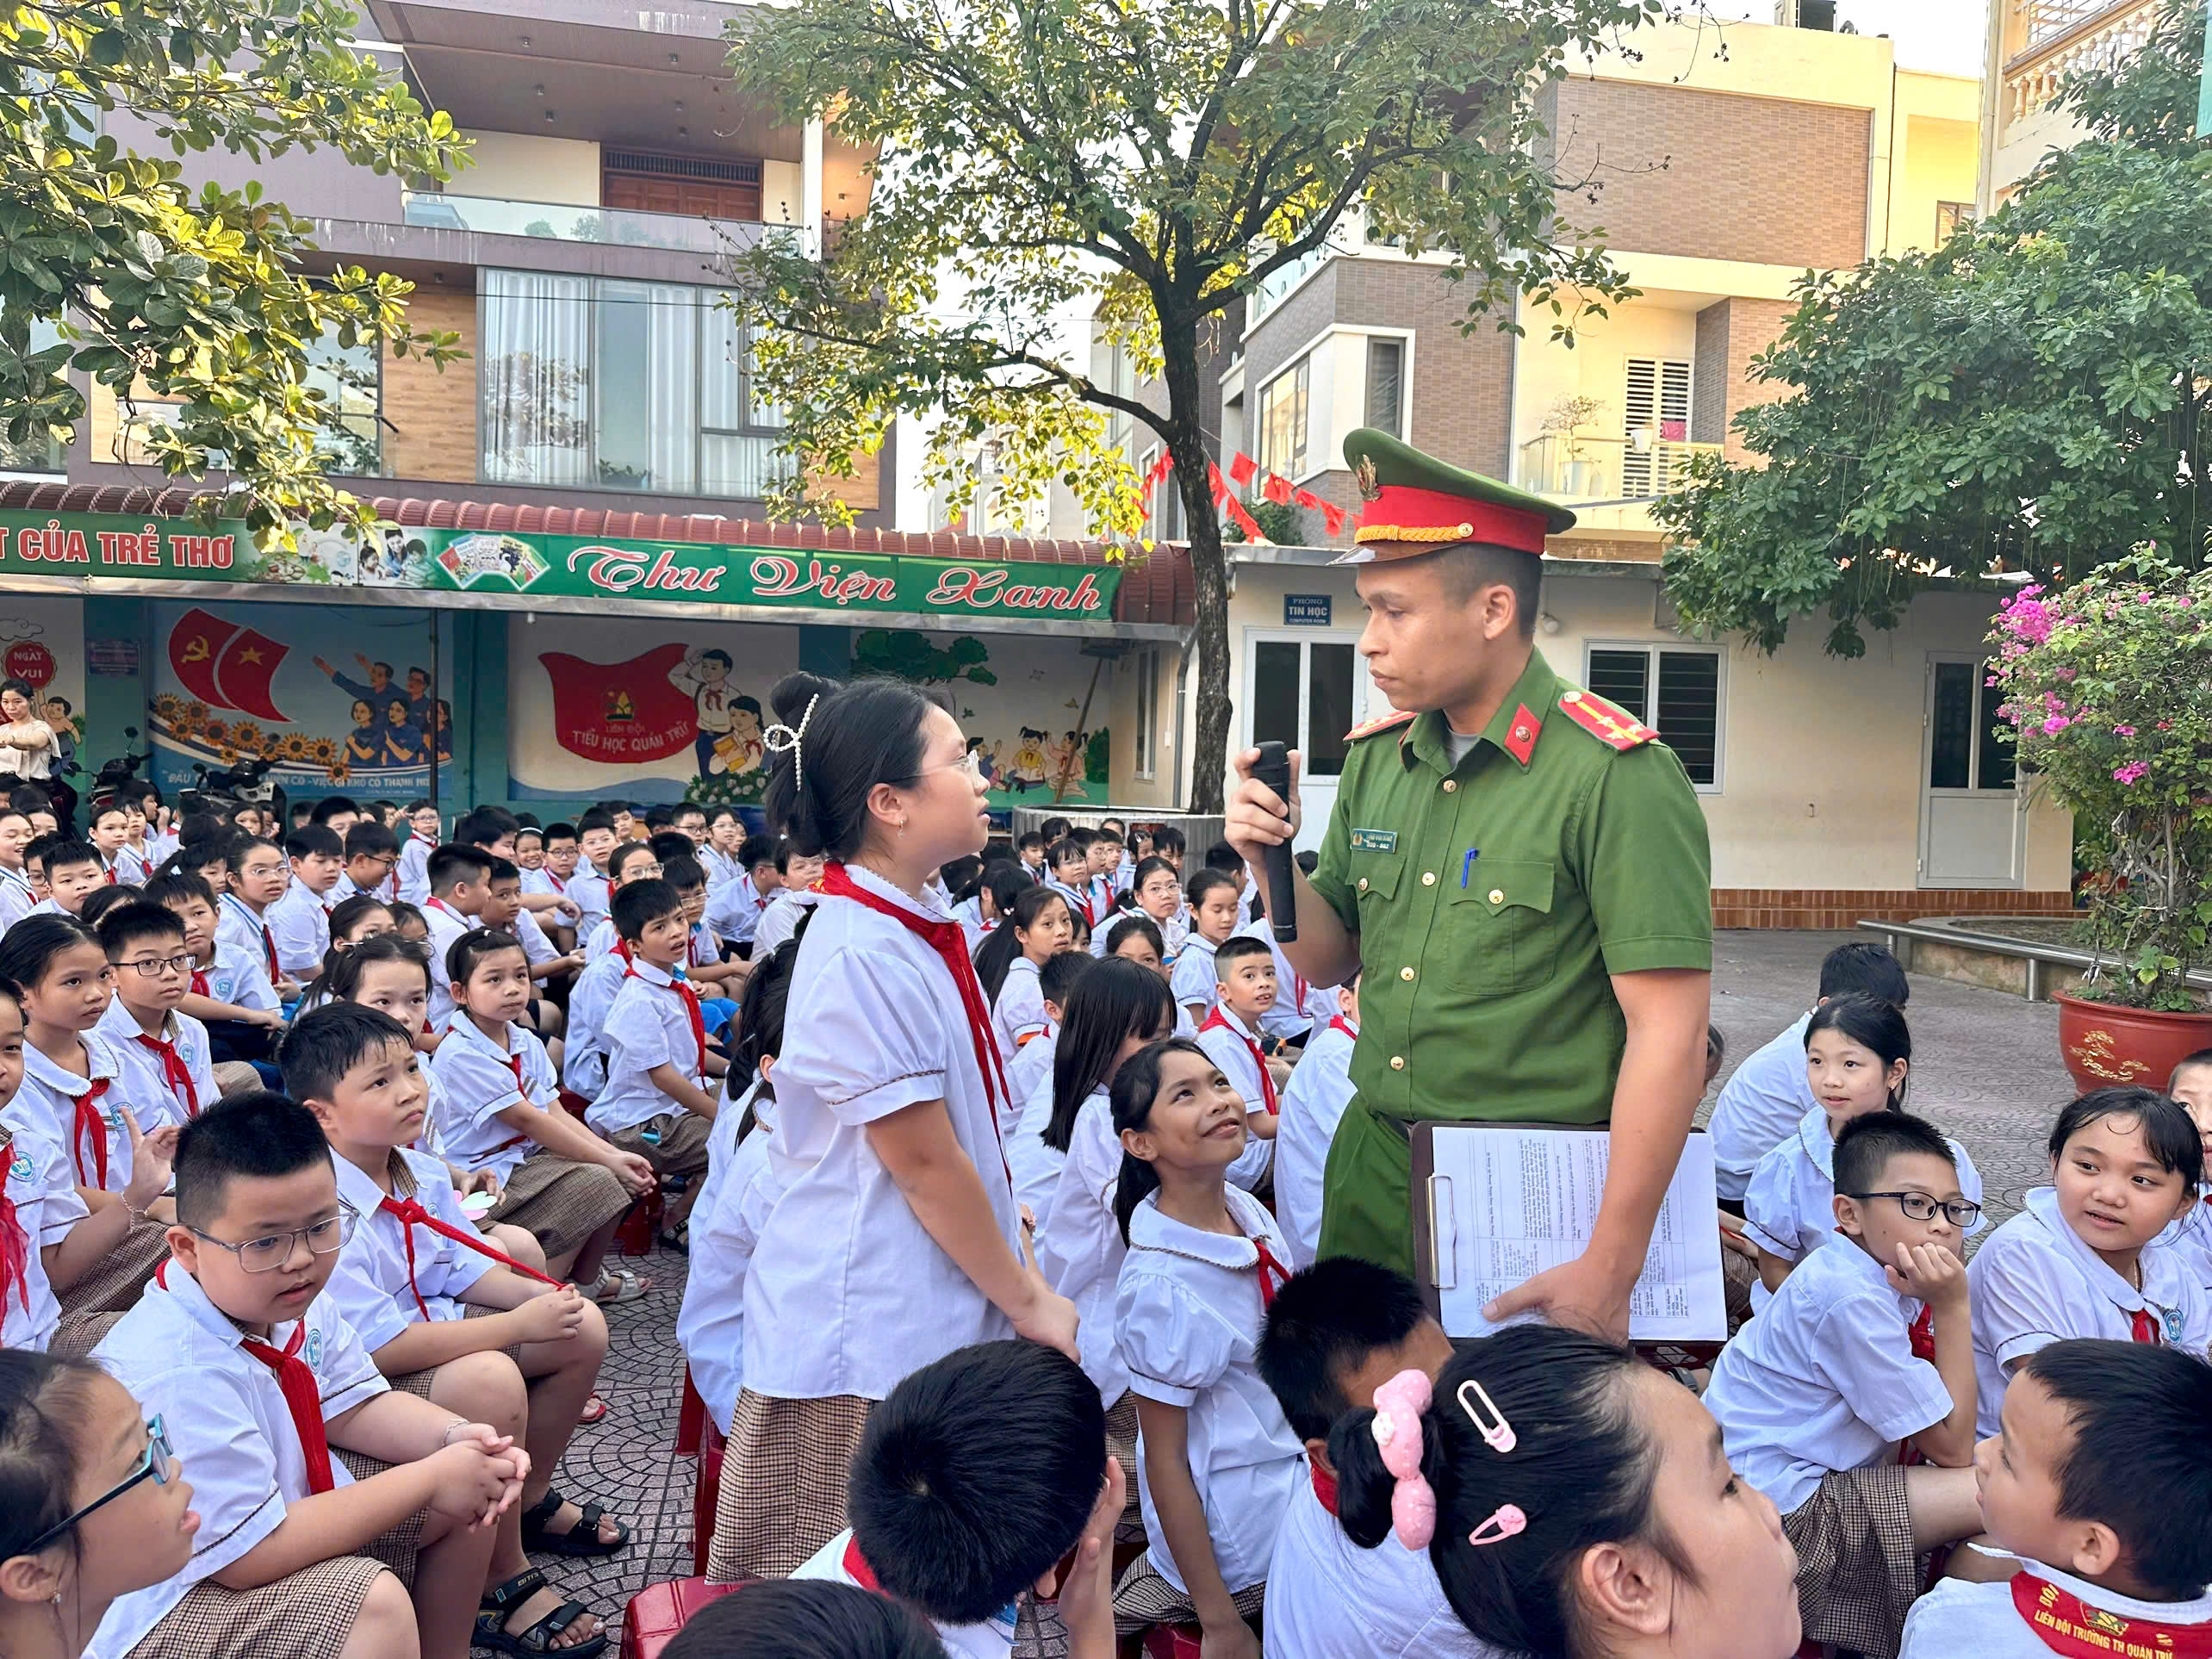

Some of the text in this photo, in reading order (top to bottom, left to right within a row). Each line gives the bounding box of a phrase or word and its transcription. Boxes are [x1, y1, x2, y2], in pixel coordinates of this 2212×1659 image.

[18, 519, 90, 562] CỦA
[97, 524, 161, 565] TRẺ
[169, 534, 234, 569] THƠ
[568, 546, 1101, 610] Thư Viện Xanh
[1289, 606, 1327, 618] TIN HỌC
[14, 648, 42, 662] NGÀY
[15, 668, 42, 678] VUI
[572, 727, 600, 747] TIỂU
[603, 736, 627, 755] HỌC
[631, 731, 664, 752] QUÁN
[2034, 1609, 2056, 1628] LIÊN
[2073, 1625, 2110, 1649] TRƯỜNG
[2112, 1638, 2125, 1654] TH
